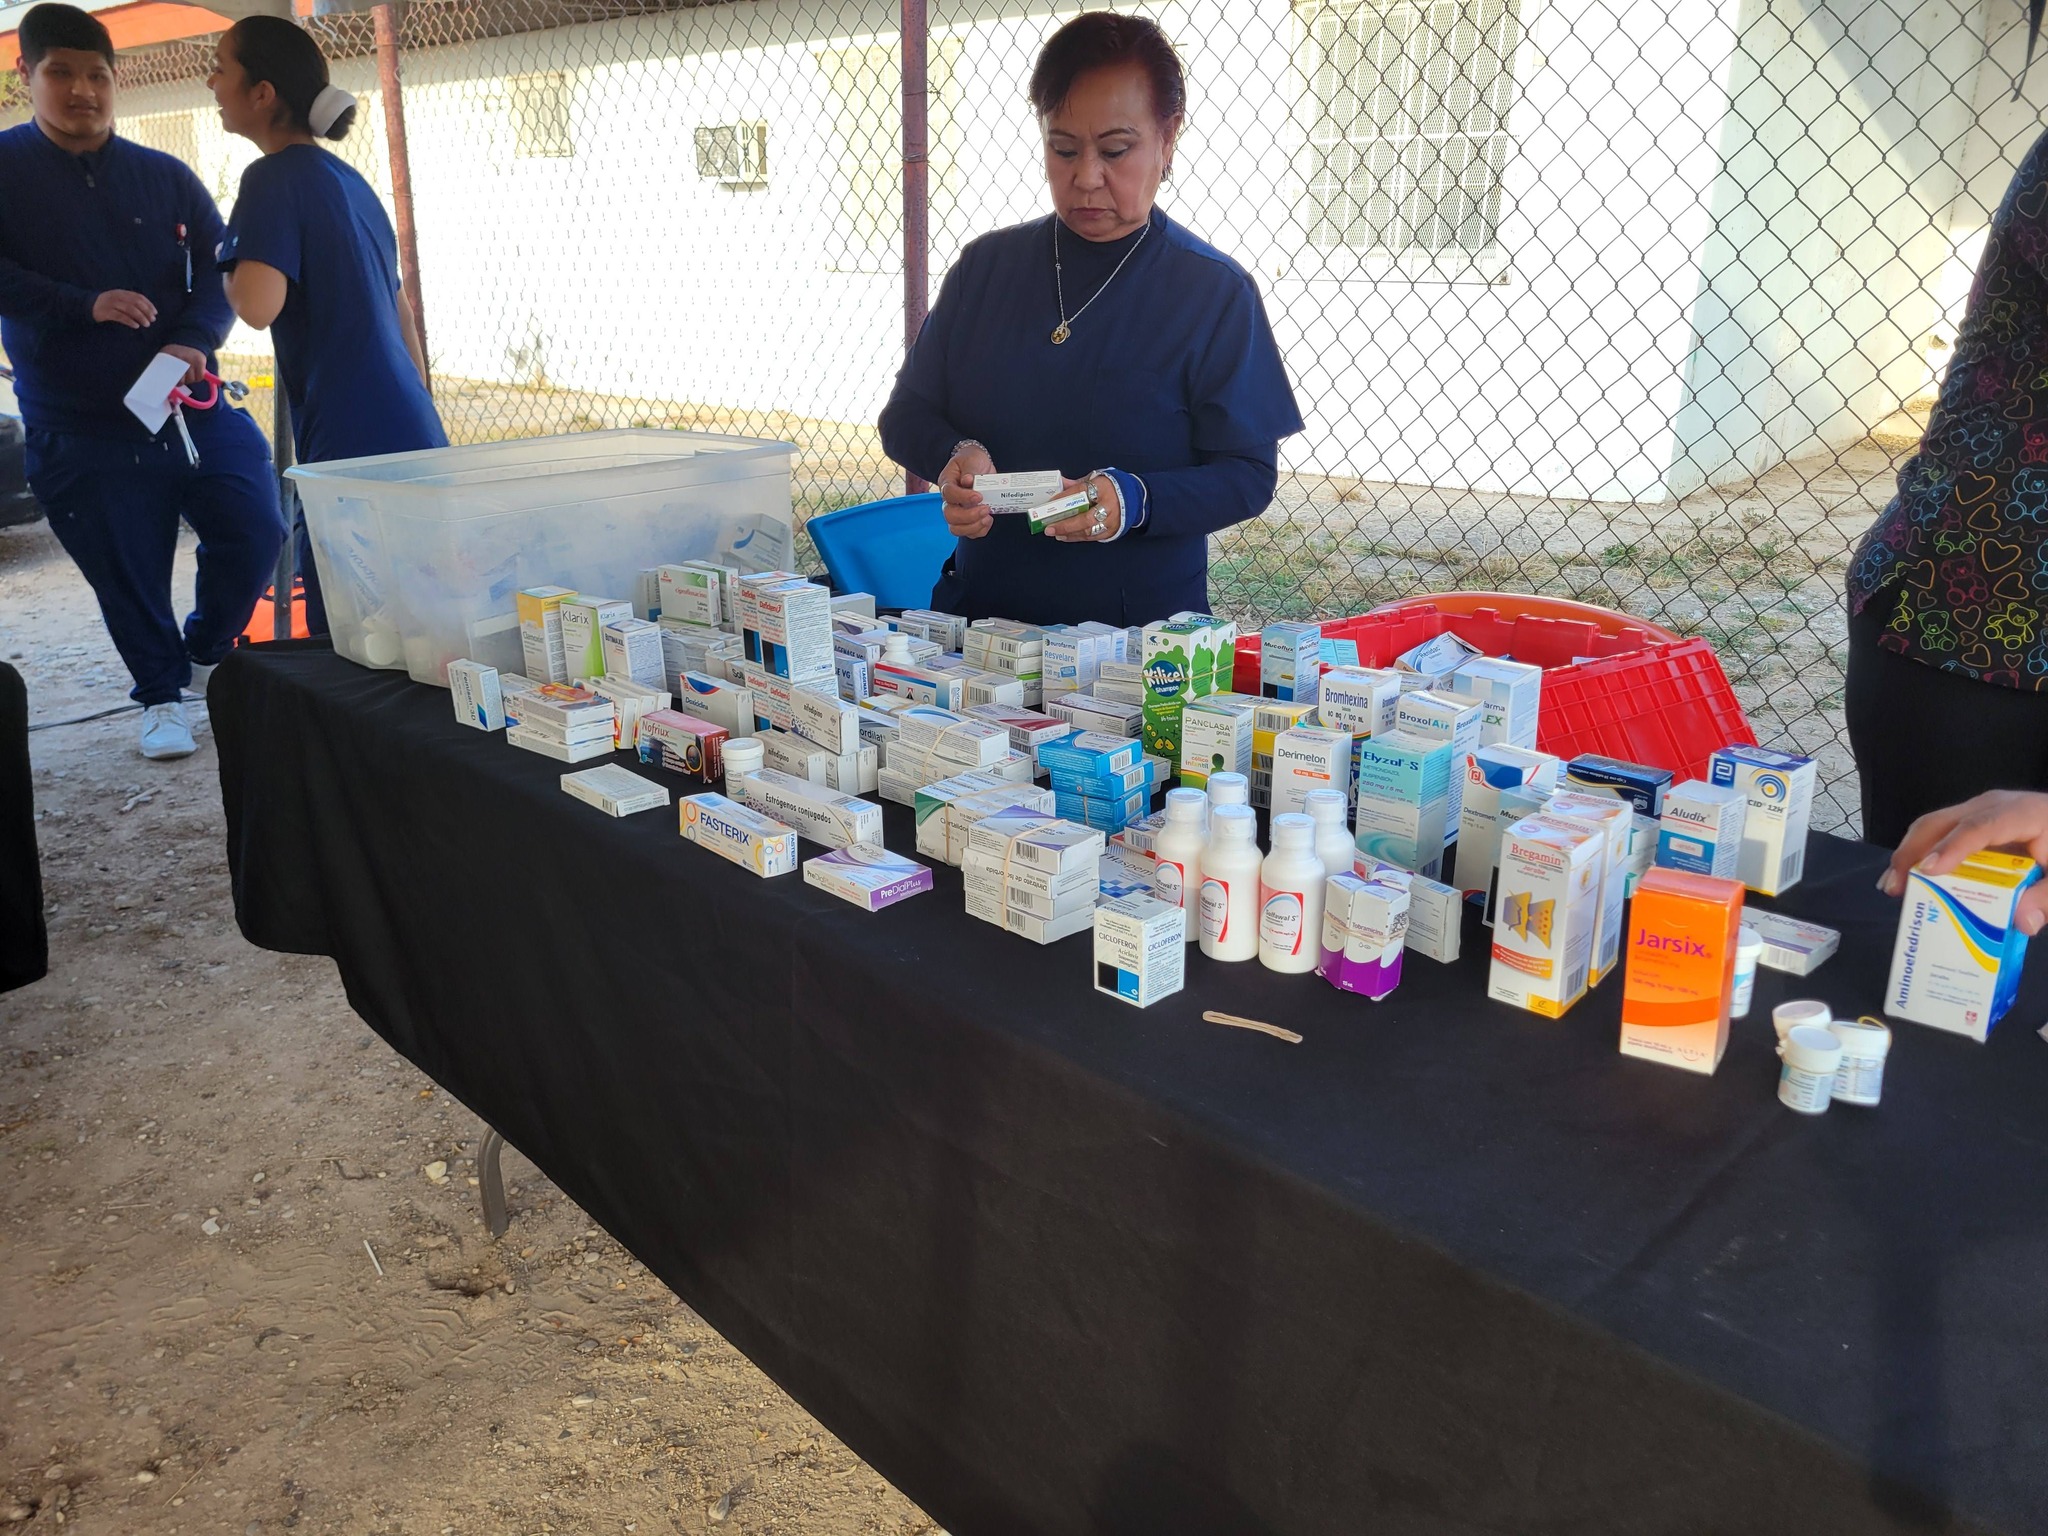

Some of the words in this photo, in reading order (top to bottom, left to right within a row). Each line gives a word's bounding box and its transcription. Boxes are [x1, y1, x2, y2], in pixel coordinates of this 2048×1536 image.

[562, 610, 589, 625] Klarix
[600, 611, 617, 620] Klarix
[1050, 641, 1076, 650] eurofarma
[1263, 641, 1295, 652] Mucoflux
[1044, 651, 1075, 662] Resvelare
[1326, 688, 1368, 708] Bromhexina
[803, 704, 823, 719] nifedipino
[642, 720, 669, 738] Nofriux
[1185, 717, 1230, 731] PANCLASA
[768, 748, 790, 763] nifedipino
[1278, 748, 1326, 764] Derimeton
[765, 792, 797, 811] Estrógenos
[798, 806, 831, 824] conjugados
[1670, 807, 1707, 823] Aludix
[700, 812, 749, 846] FASTERIX
[1512, 843, 1561, 866] Bregamin
[1523, 865, 1546, 875] Jarabe
[1024, 879, 1047, 892] Dinitrato
[1927, 905, 1939, 923] NF
[1352, 922, 1384, 935] Tobramicina
[1099, 932, 1138, 951] CICLOFERON
[1148, 932, 1182, 951] CICLOFERON
[1636, 929, 1705, 958] Jarsix
[1118, 949, 1138, 960] Aciclovir
[1897, 902, 1926, 1009] Aminoefedrison
